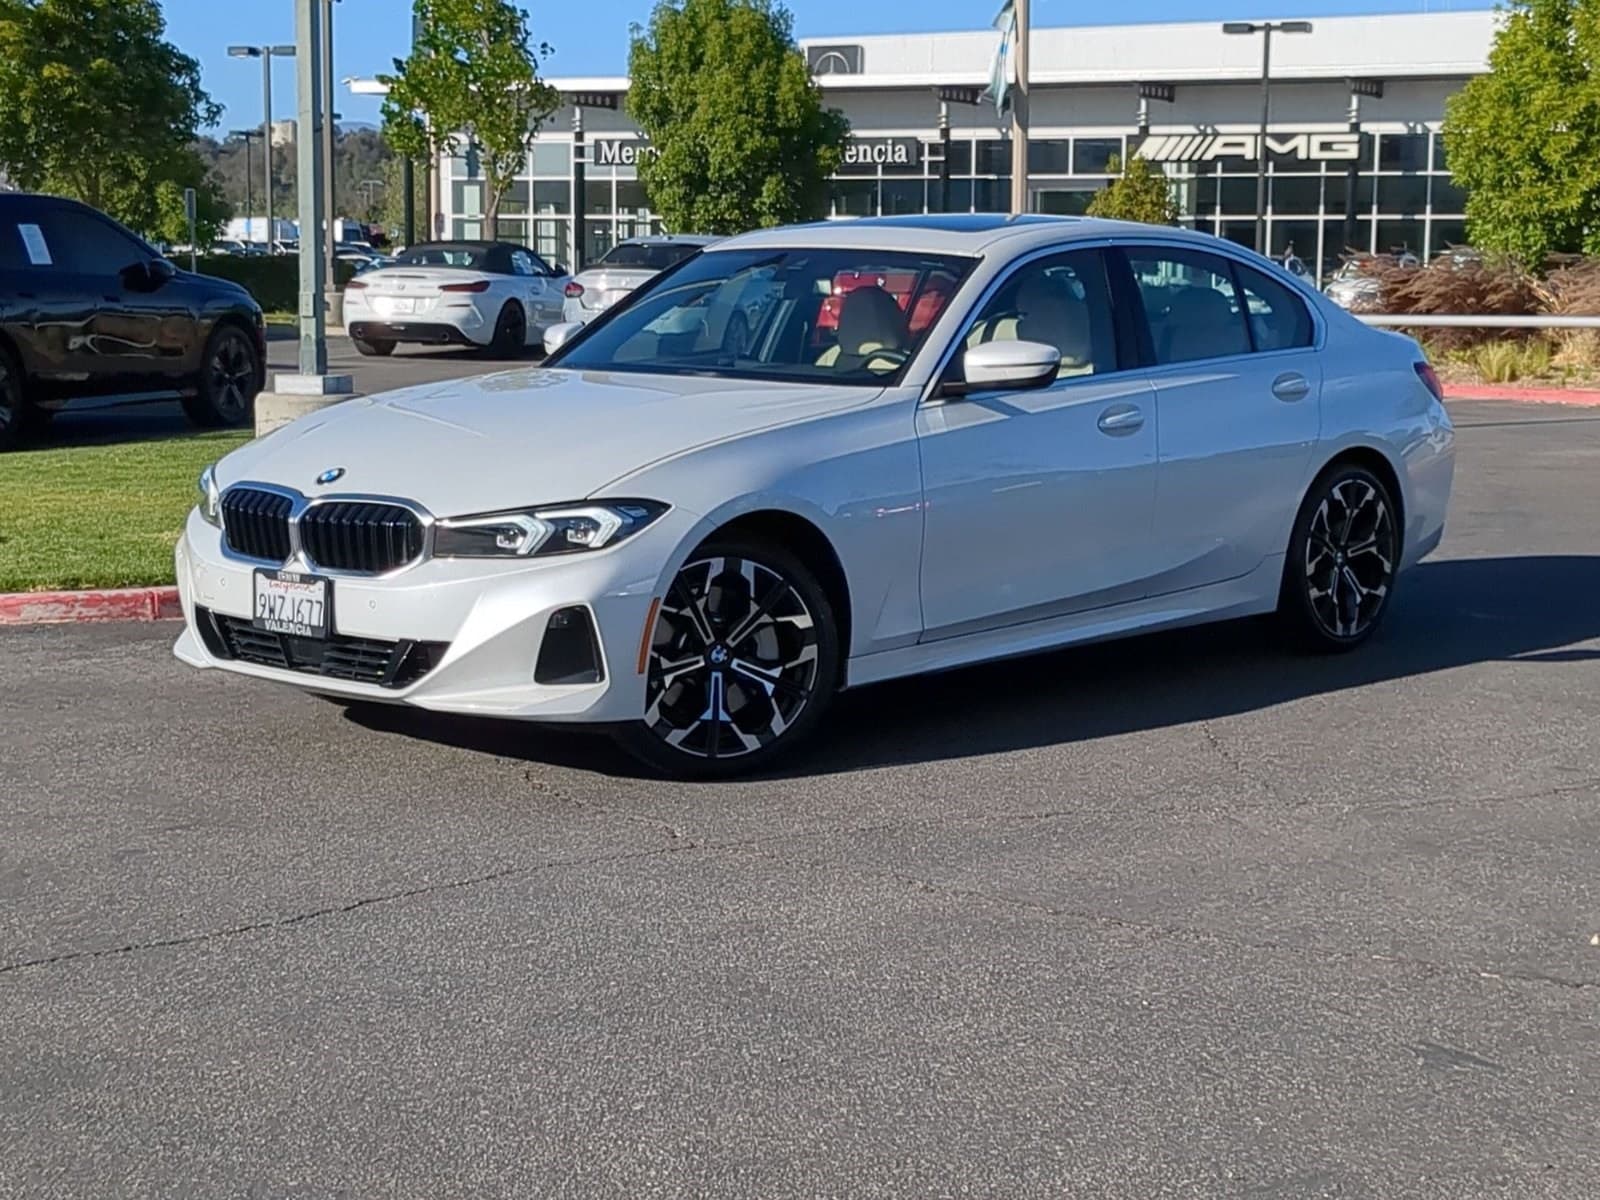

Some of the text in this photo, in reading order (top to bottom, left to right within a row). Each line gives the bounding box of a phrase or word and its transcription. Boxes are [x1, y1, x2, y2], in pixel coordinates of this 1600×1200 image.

[1201, 134, 1359, 160] AMG
[259, 593, 323, 626] 9WZJ677
[264, 619, 312, 637] VALENCIA
